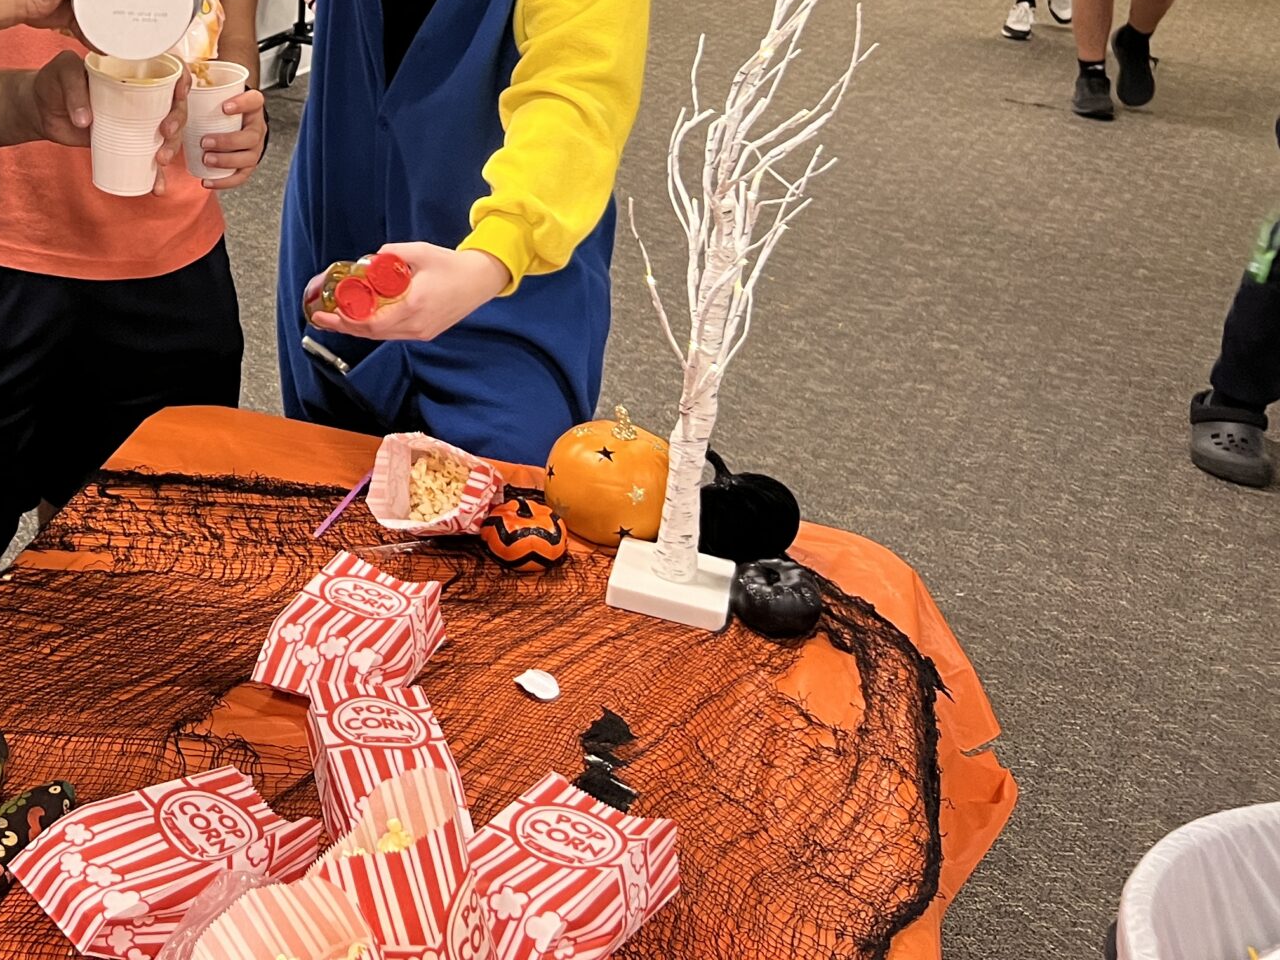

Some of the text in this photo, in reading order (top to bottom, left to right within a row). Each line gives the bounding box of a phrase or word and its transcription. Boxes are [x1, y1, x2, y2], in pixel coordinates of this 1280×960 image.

[333, 588, 395, 613] CORN
[351, 583, 393, 601] POP
[345, 717, 416, 733] CORN
[351, 704, 400, 718] POP
[178, 800, 237, 854] CORN
[206, 802, 246, 839] POP
[555, 813, 607, 841] POP
[529, 818, 607, 858] CORN
[461, 887, 479, 929] PO
